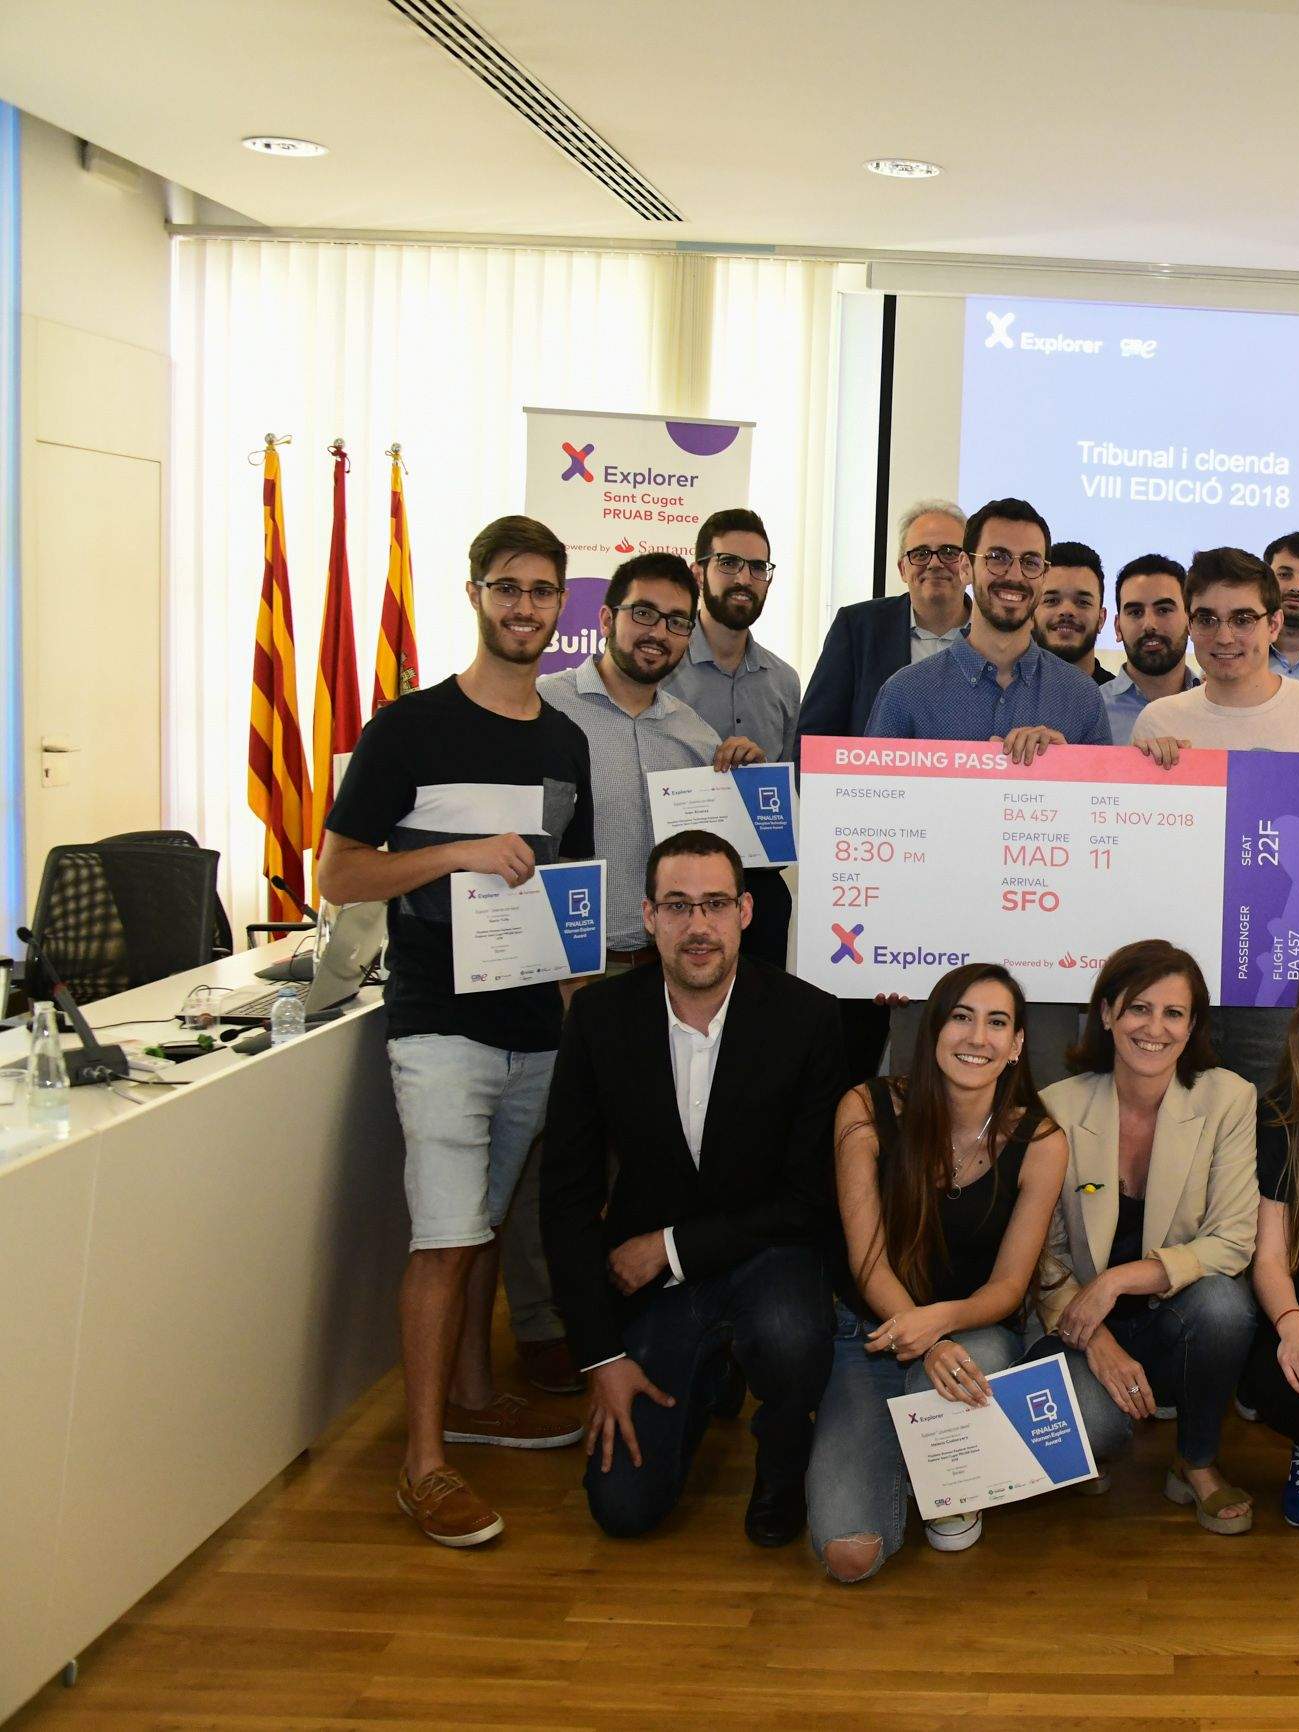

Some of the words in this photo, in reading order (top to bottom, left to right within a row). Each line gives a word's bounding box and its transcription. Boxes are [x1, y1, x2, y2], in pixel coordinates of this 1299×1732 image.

[1020, 333, 1102, 354] Explorer
[1077, 441, 1174, 468] Tribunal
[1182, 446, 1188, 469] i
[1194, 450, 1289, 476] cloenda
[604, 465, 698, 488] Explorer
[604, 491, 638, 504] Sant
[641, 493, 684, 508] Cugat
[1080, 474, 1122, 498] VIII
[1130, 477, 1222, 503] EDICIÓ
[1230, 483, 1290, 508] 2018
[603, 508, 653, 522] PRUAB
[657, 511, 699, 525] Space
[565, 544, 598, 552] owered
[600, 544, 610, 554] by
[835, 748, 949, 768] BOARDING
[954, 752, 1008, 770] PASS
[835, 788, 906, 800] PASSENGER
[1004, 794, 1044, 804] FLIGHT
[1090, 796, 1120, 806] DATE
[1004, 808, 1025, 822] BA
[1030, 808, 1058, 822] 457
[1091, 812, 1106, 824] 15
[1116, 812, 1152, 826] NOV
[1157, 812, 1194, 827] 2018
[834, 827, 896, 838] BOARDING
[900, 828, 927, 838] TIME
[1002, 832, 1070, 843] DEPARTURE
[1090, 834, 1119, 845] GATE
[834, 841, 894, 862] 8:30
[904, 851, 926, 864] PM
[1242, 835, 1252, 866] SEAT
[1258, 820, 1279, 866] 22F
[1003, 845, 1070, 868] MAD
[1090, 848, 1112, 870] 11
[832, 872, 860, 882] SEAT
[1001, 876, 1048, 888] ARRIVAL
[832, 886, 880, 908] 22F
[1001, 891, 1060, 912] SFO
[1238, 905, 1250, 979] PASSENGER
[1288, 930, 1299, 959] 457
[873, 946, 970, 969] Explorer
[1004, 958, 1042, 967] Powered
[1044, 959, 1054, 968] by
[1273, 936, 1284, 980] FLIGHT
[1288, 960, 1299, 980] BA
[1032, 1420, 1067, 1436] FINALISTA
